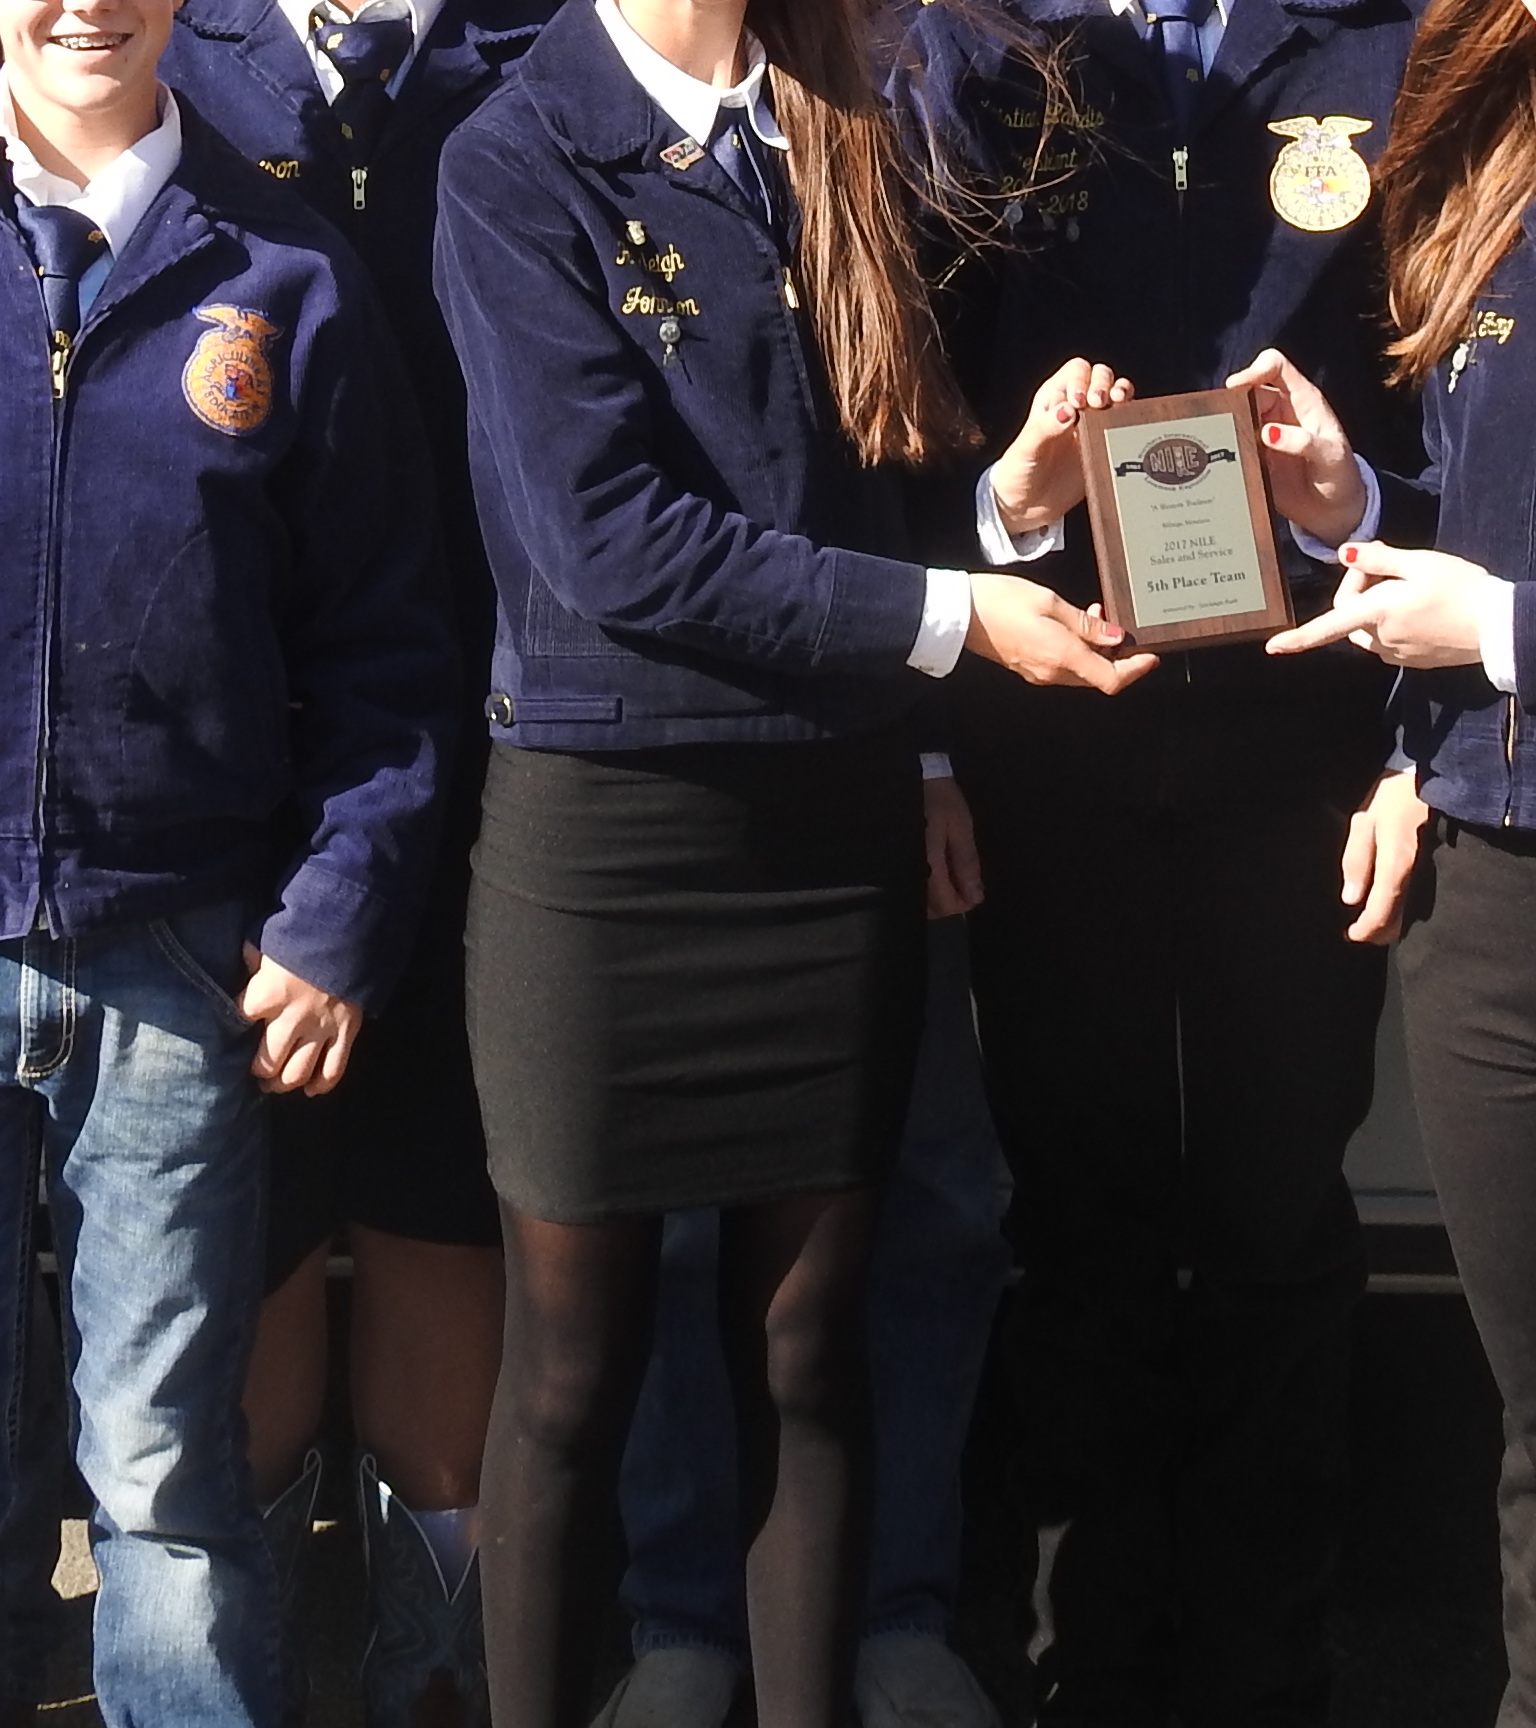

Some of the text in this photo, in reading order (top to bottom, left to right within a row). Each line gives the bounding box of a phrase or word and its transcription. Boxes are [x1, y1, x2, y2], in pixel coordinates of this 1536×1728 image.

[1163, 535, 1217, 553] 2017 NILE
[1149, 546, 1234, 567] Sales and Service
[1146, 570, 1246, 594] 5th Place Team
